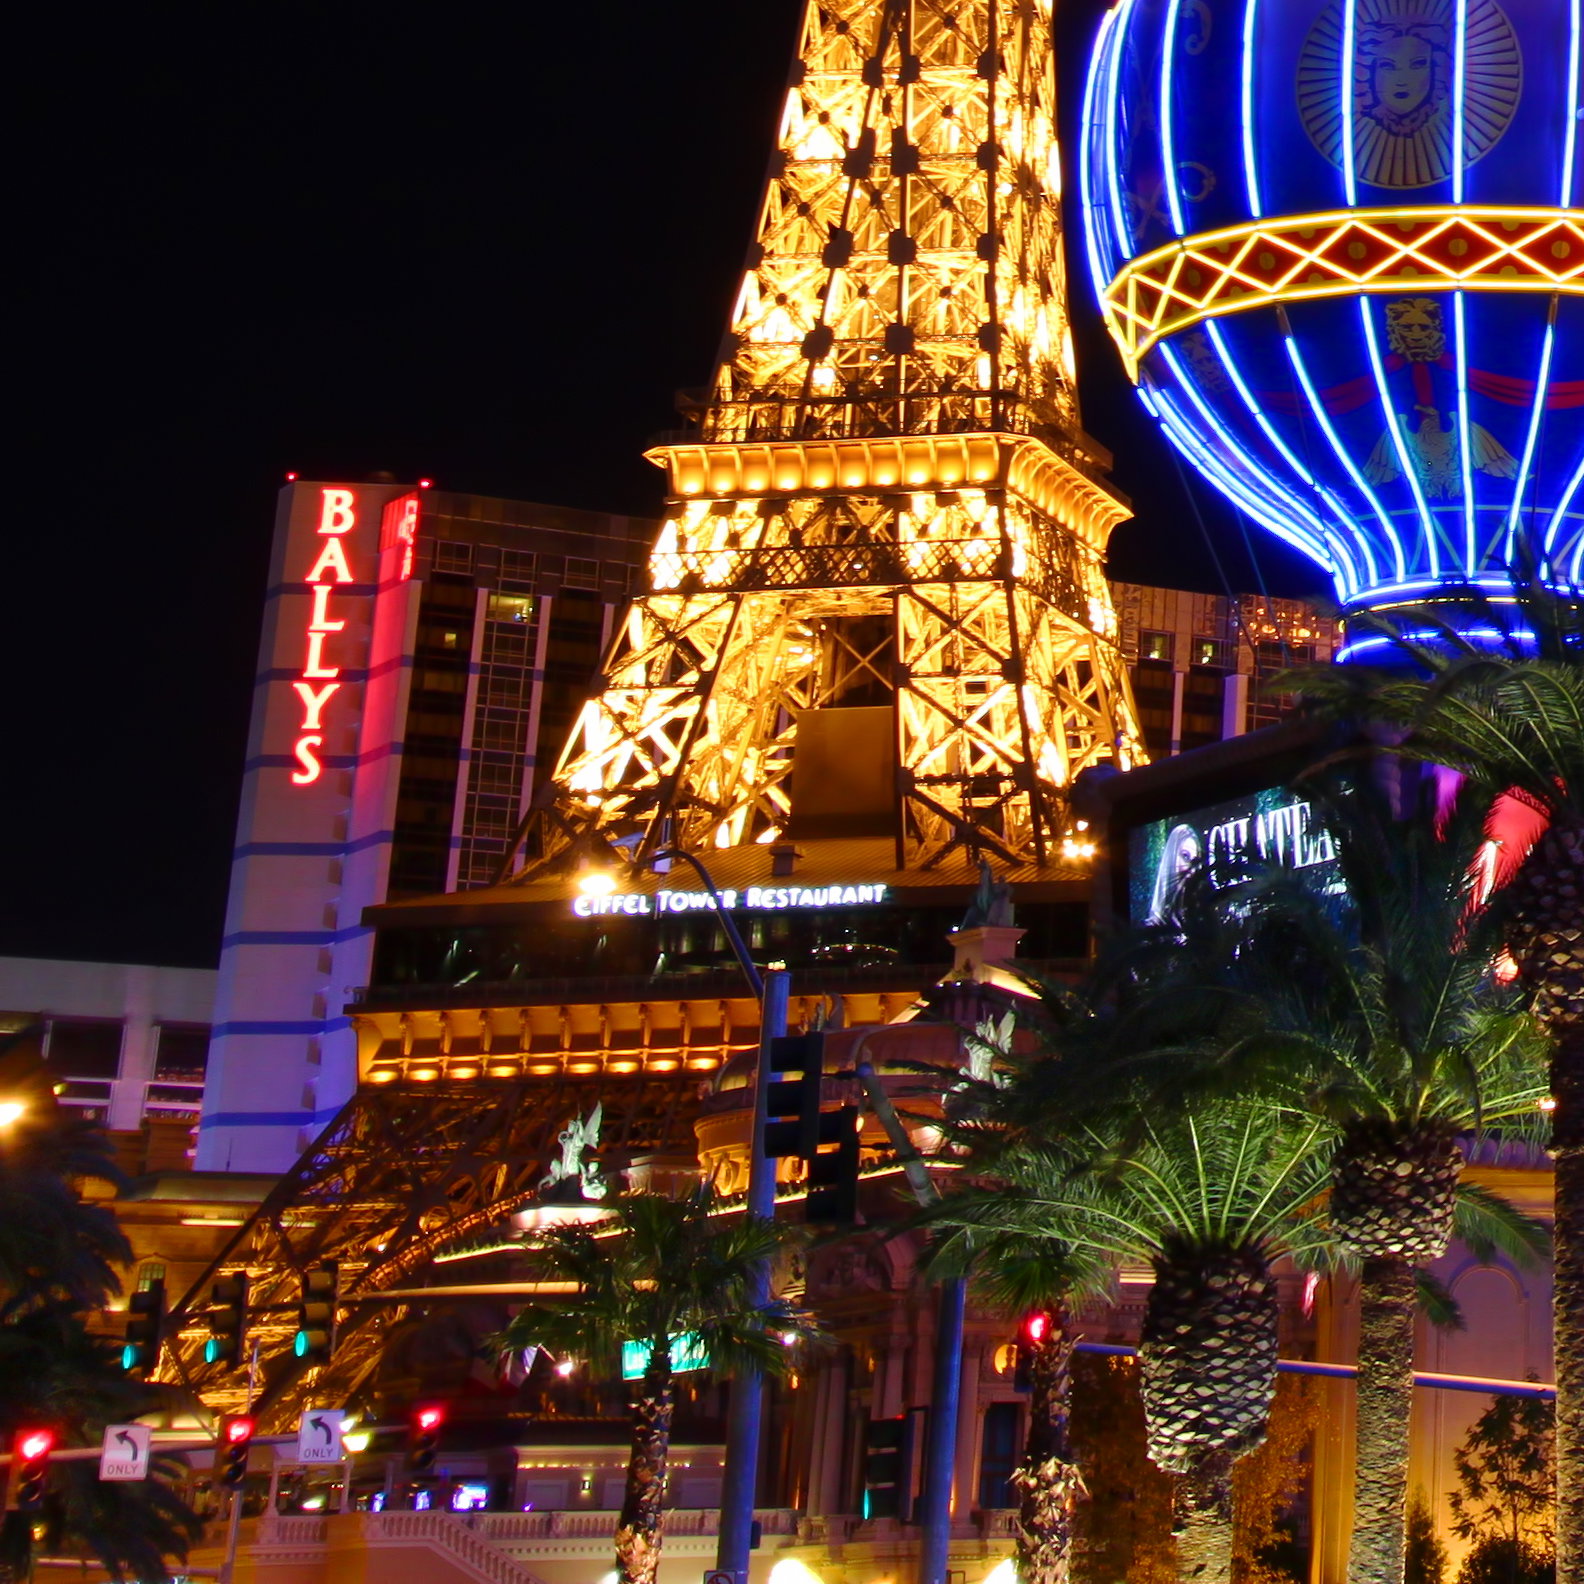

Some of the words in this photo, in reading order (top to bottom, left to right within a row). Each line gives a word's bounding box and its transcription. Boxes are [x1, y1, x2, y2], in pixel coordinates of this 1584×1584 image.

[573, 893, 650, 917] EIFFEL
[746, 883, 888, 910] RESTAURANT
[303, 1447, 335, 1459] ONLY
[106, 1463, 139, 1476] ONLY
